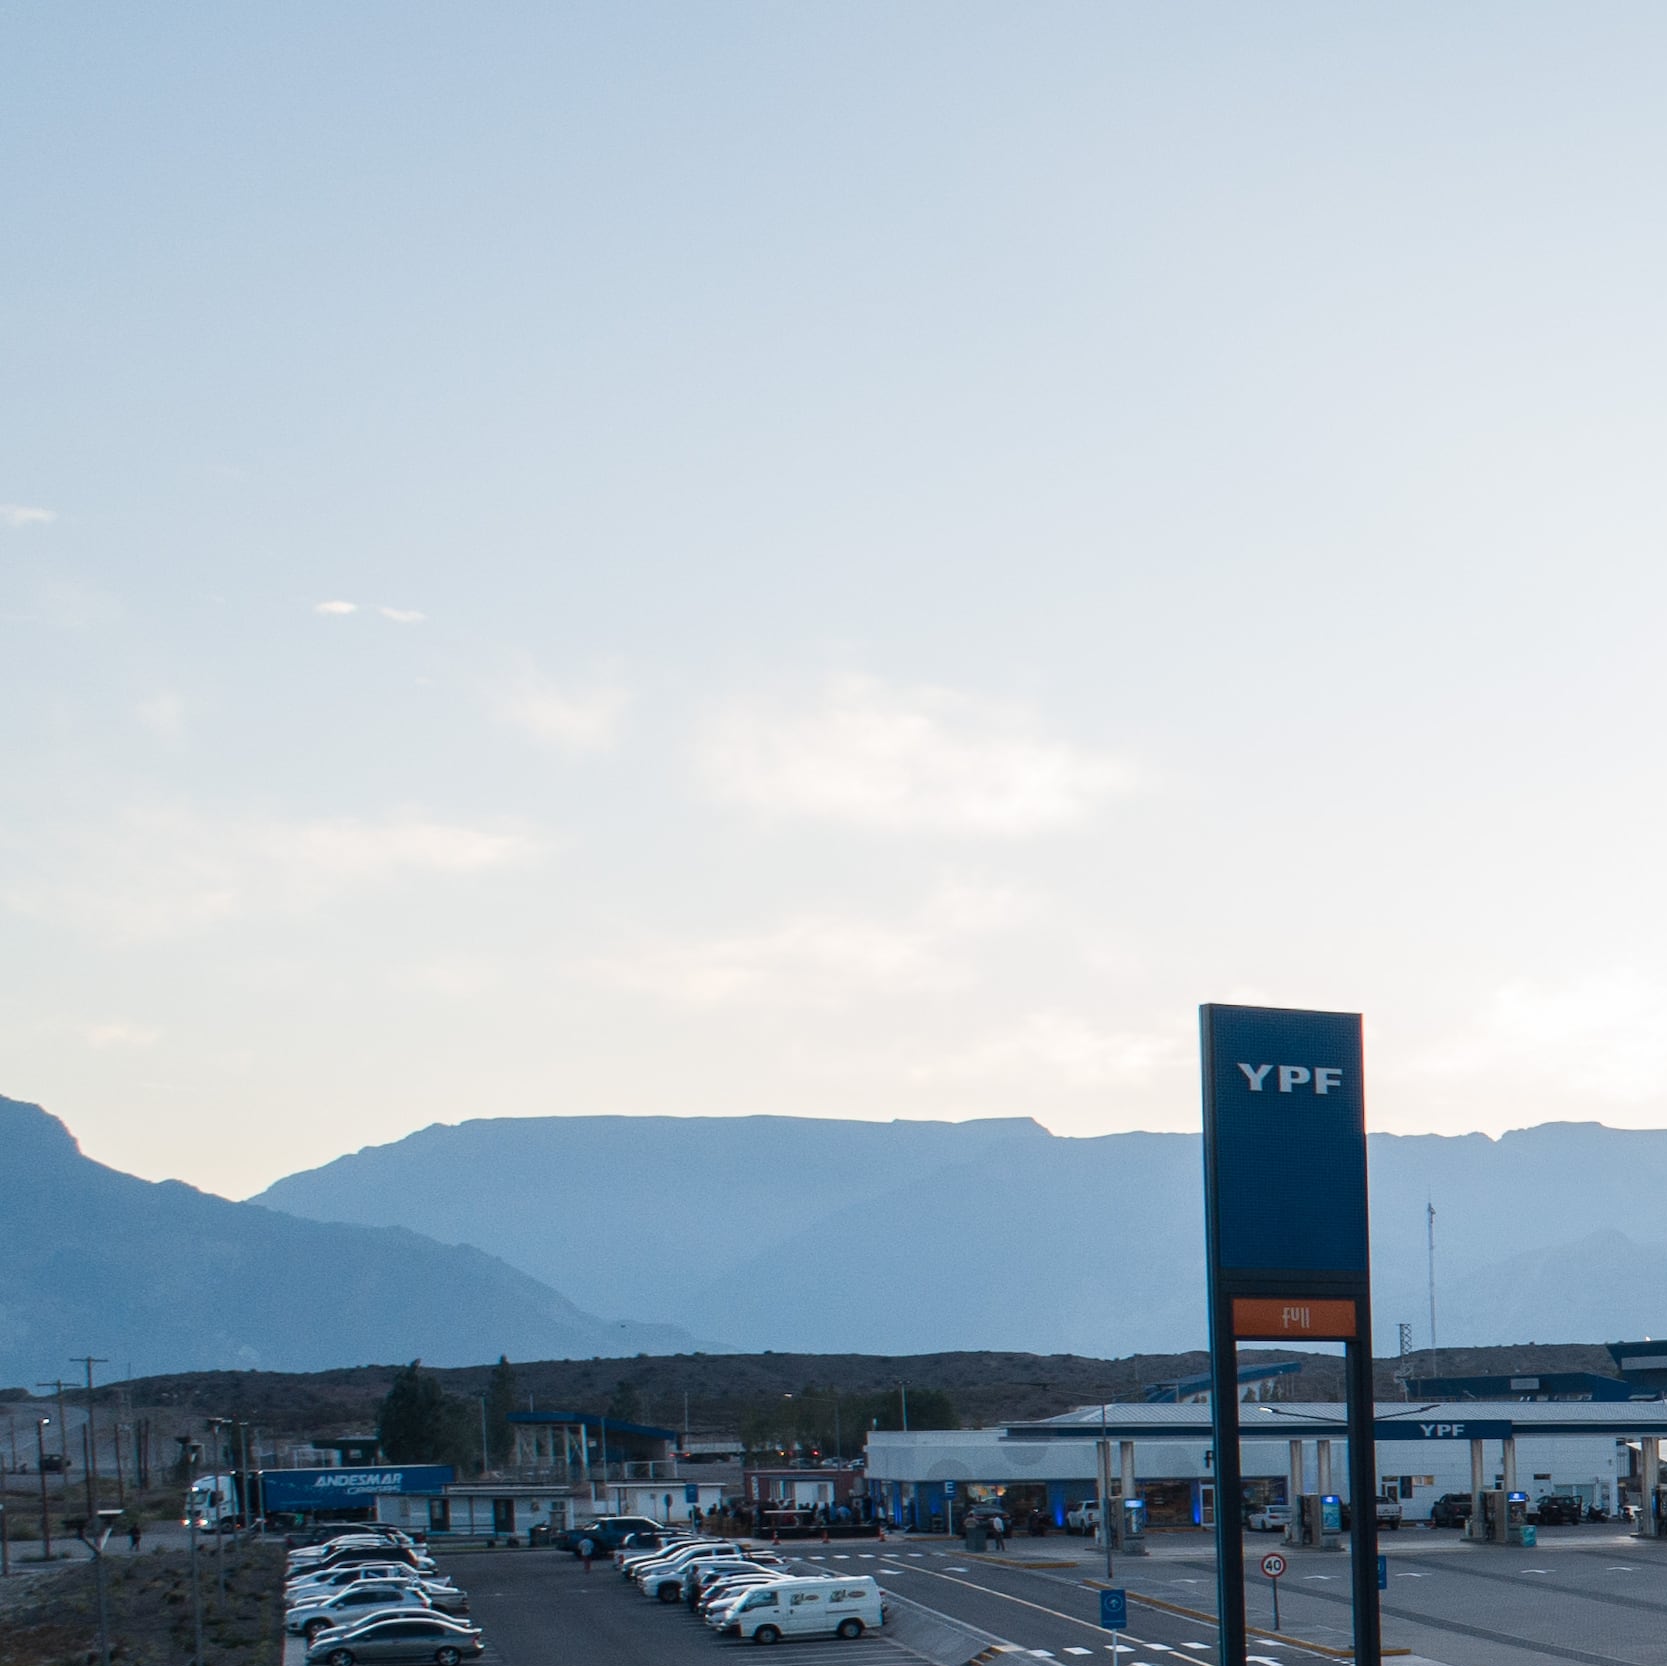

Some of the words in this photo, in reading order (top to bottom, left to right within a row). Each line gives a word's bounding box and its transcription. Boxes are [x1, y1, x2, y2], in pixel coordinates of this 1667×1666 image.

[1236, 1063, 1343, 1095] YPF
[1282, 1307, 1311, 1329] full
[1419, 1424, 1465, 1437] YPF
[314, 1472, 403, 1487] ANDESMAR
[945, 1481, 954, 1494] E
[1265, 1559, 1281, 1572] 40
